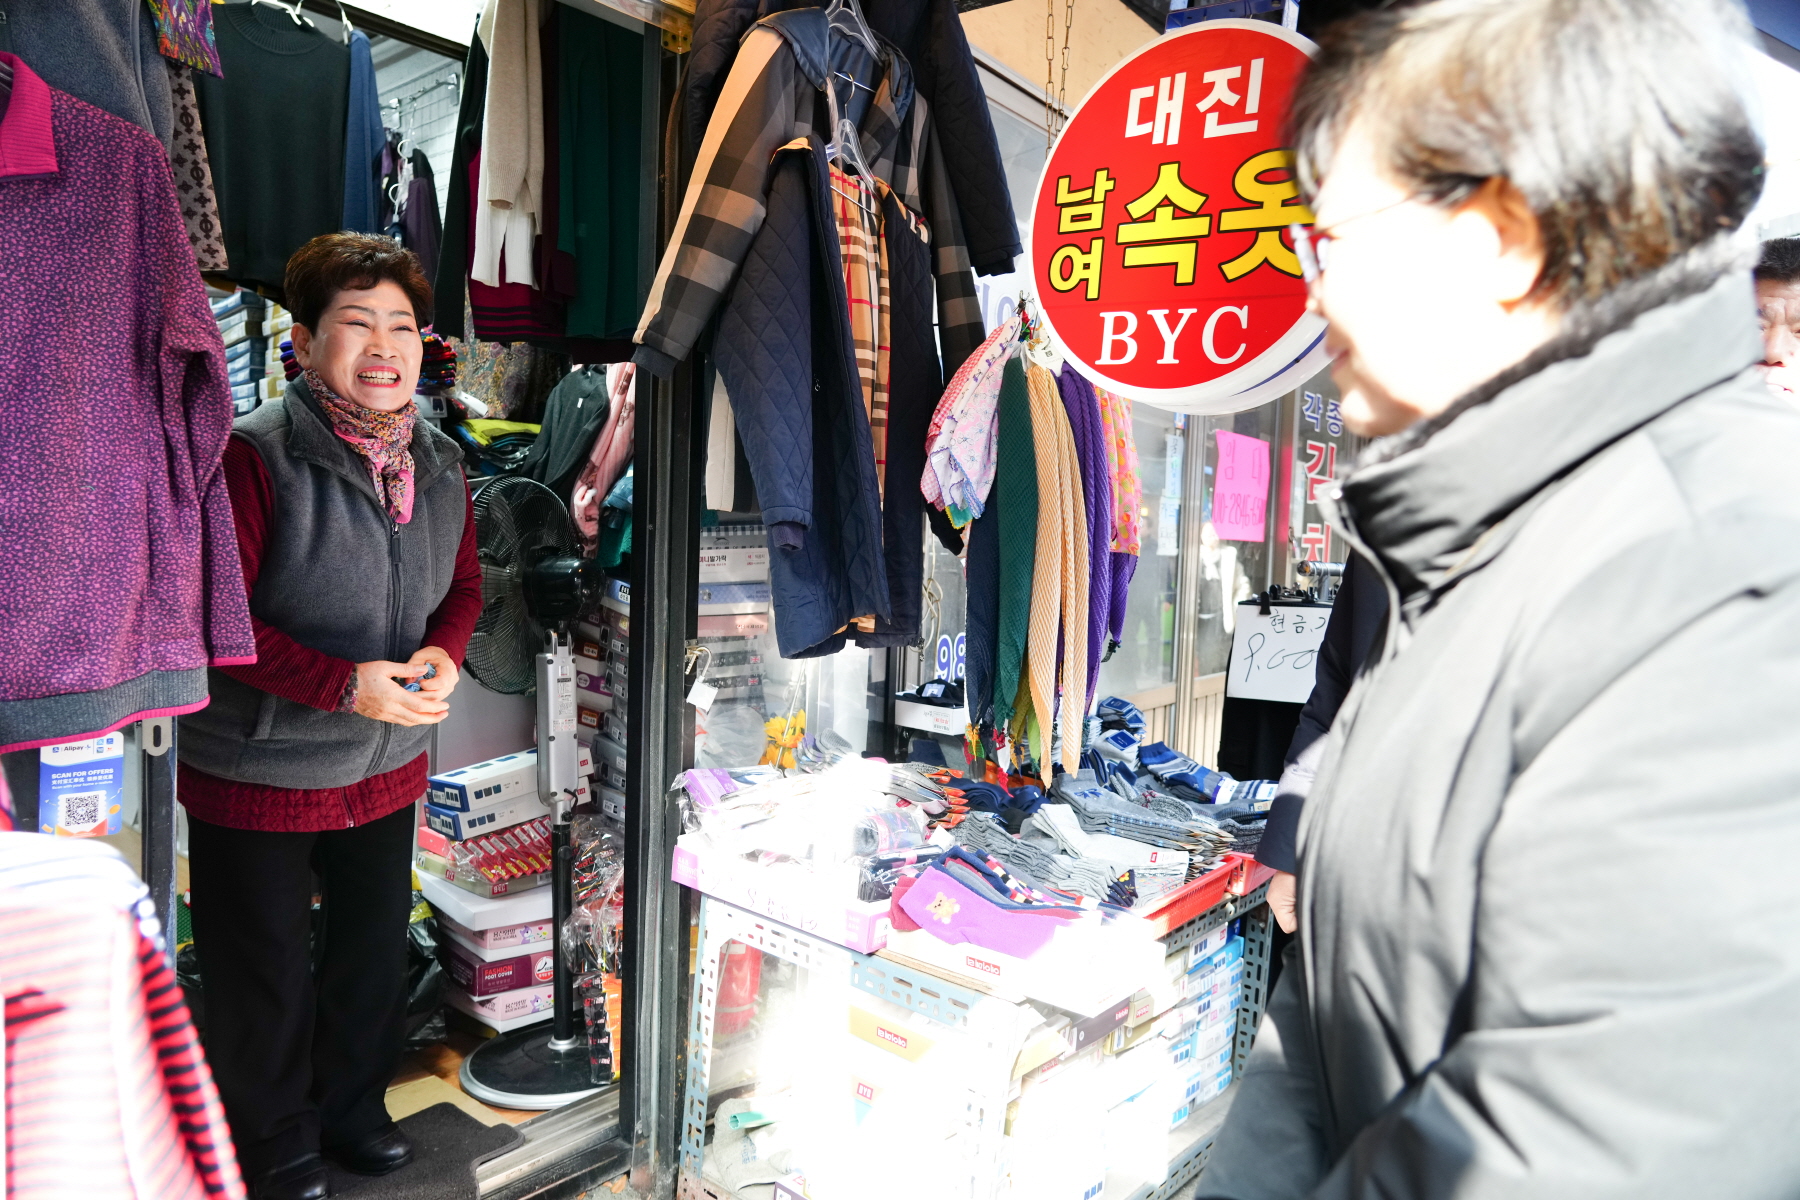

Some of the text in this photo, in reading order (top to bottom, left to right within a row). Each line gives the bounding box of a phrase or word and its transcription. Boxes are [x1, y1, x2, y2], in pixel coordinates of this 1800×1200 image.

[1124, 57, 1264, 146] 대진
[1095, 304, 1249, 367] BYC
[1302, 391, 1343, 437] 각종
[484, 965, 513, 976] FASHION
[497, 970, 513, 978] COVER
